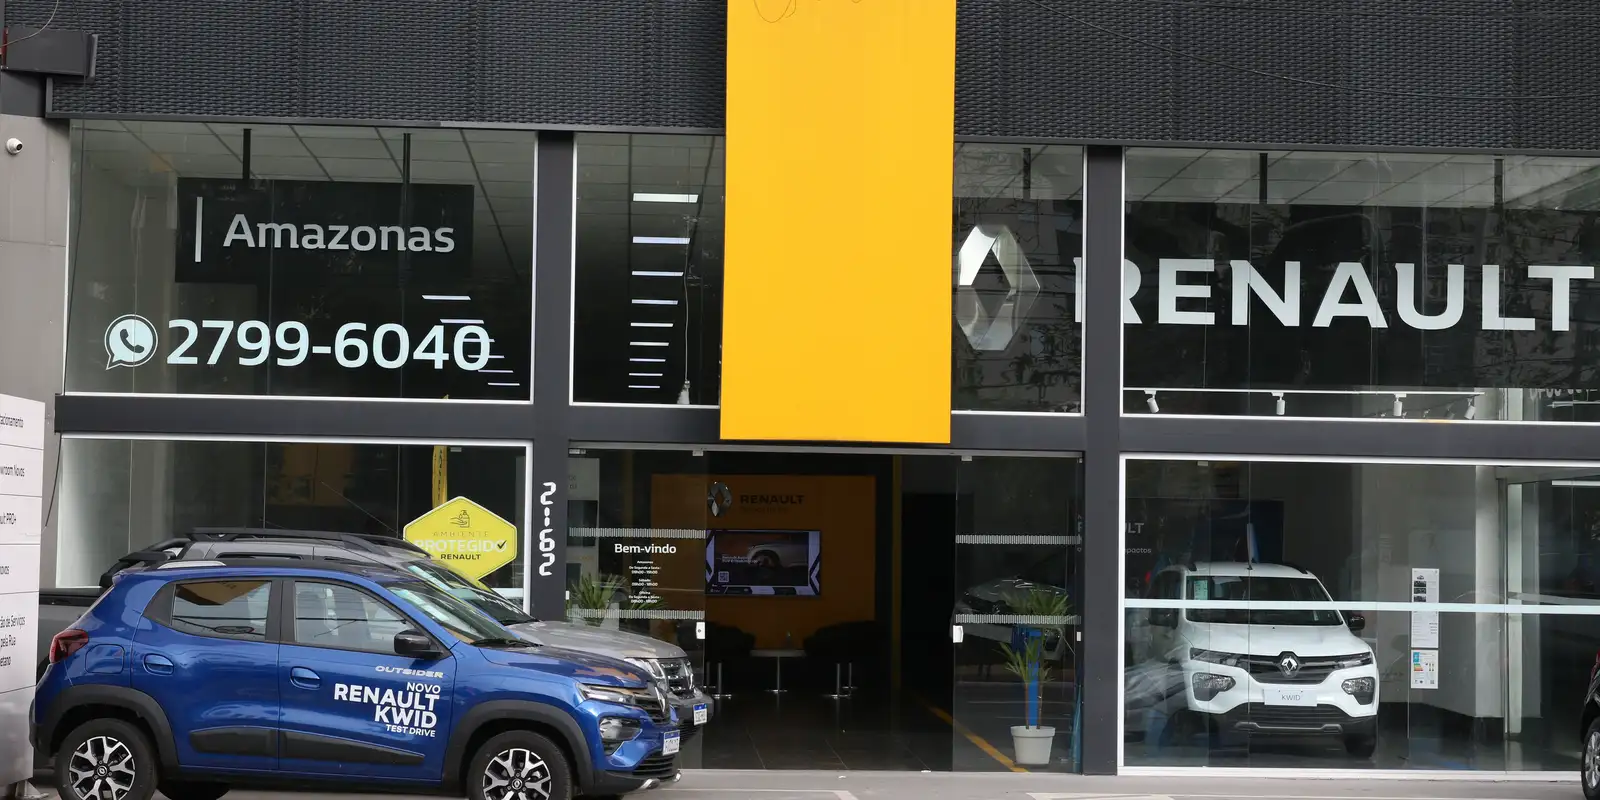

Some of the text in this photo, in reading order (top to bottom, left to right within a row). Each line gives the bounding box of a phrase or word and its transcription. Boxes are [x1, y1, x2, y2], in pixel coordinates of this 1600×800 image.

[223, 213, 455, 254] Amazonas
[166, 319, 490, 372] 2799-6040
[739, 494, 805, 505] RENAULT
[538, 481, 557, 577] 2162
[413, 539, 507, 553] PROTEGIDO
[614, 543, 677, 555] Bem-vindo
[375, 665, 444, 679] OUTSIDER
[406, 681, 441, 694] NOVO
[333, 683, 440, 711] RENAULT
[374, 704, 437, 729] KWID
[386, 724, 437, 738] TEST DRIVE
